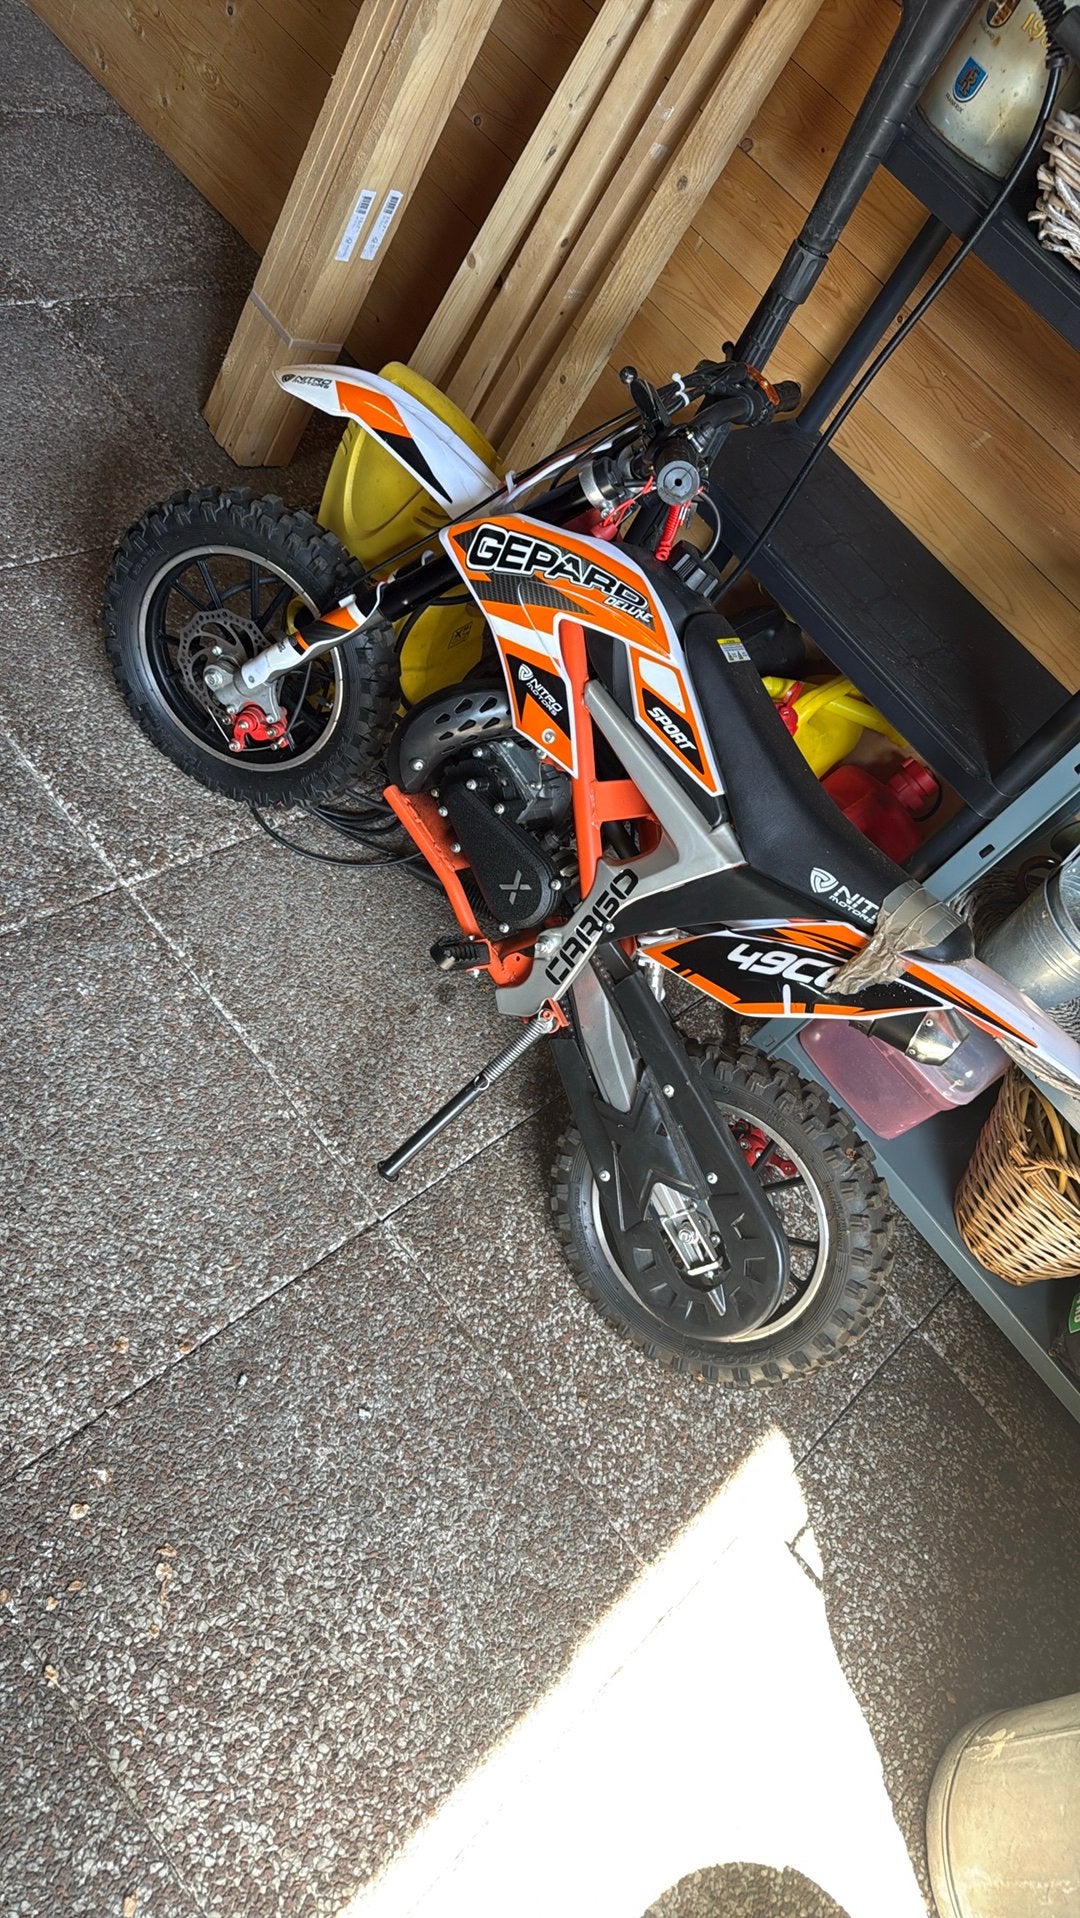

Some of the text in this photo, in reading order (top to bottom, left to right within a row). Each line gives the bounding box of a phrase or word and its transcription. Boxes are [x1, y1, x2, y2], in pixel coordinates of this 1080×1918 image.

[466, 523, 649, 610] GEPARD
[604, 596, 655, 623] DELUXE
[526, 682, 558, 716] MOTORS
[530, 678, 563, 712] NITRO
[647, 706, 697, 750] SPORT
[828, 895, 876, 925] MOTORS
[833, 885, 880, 920] NIT
[545, 868, 639, 986] CARGO
